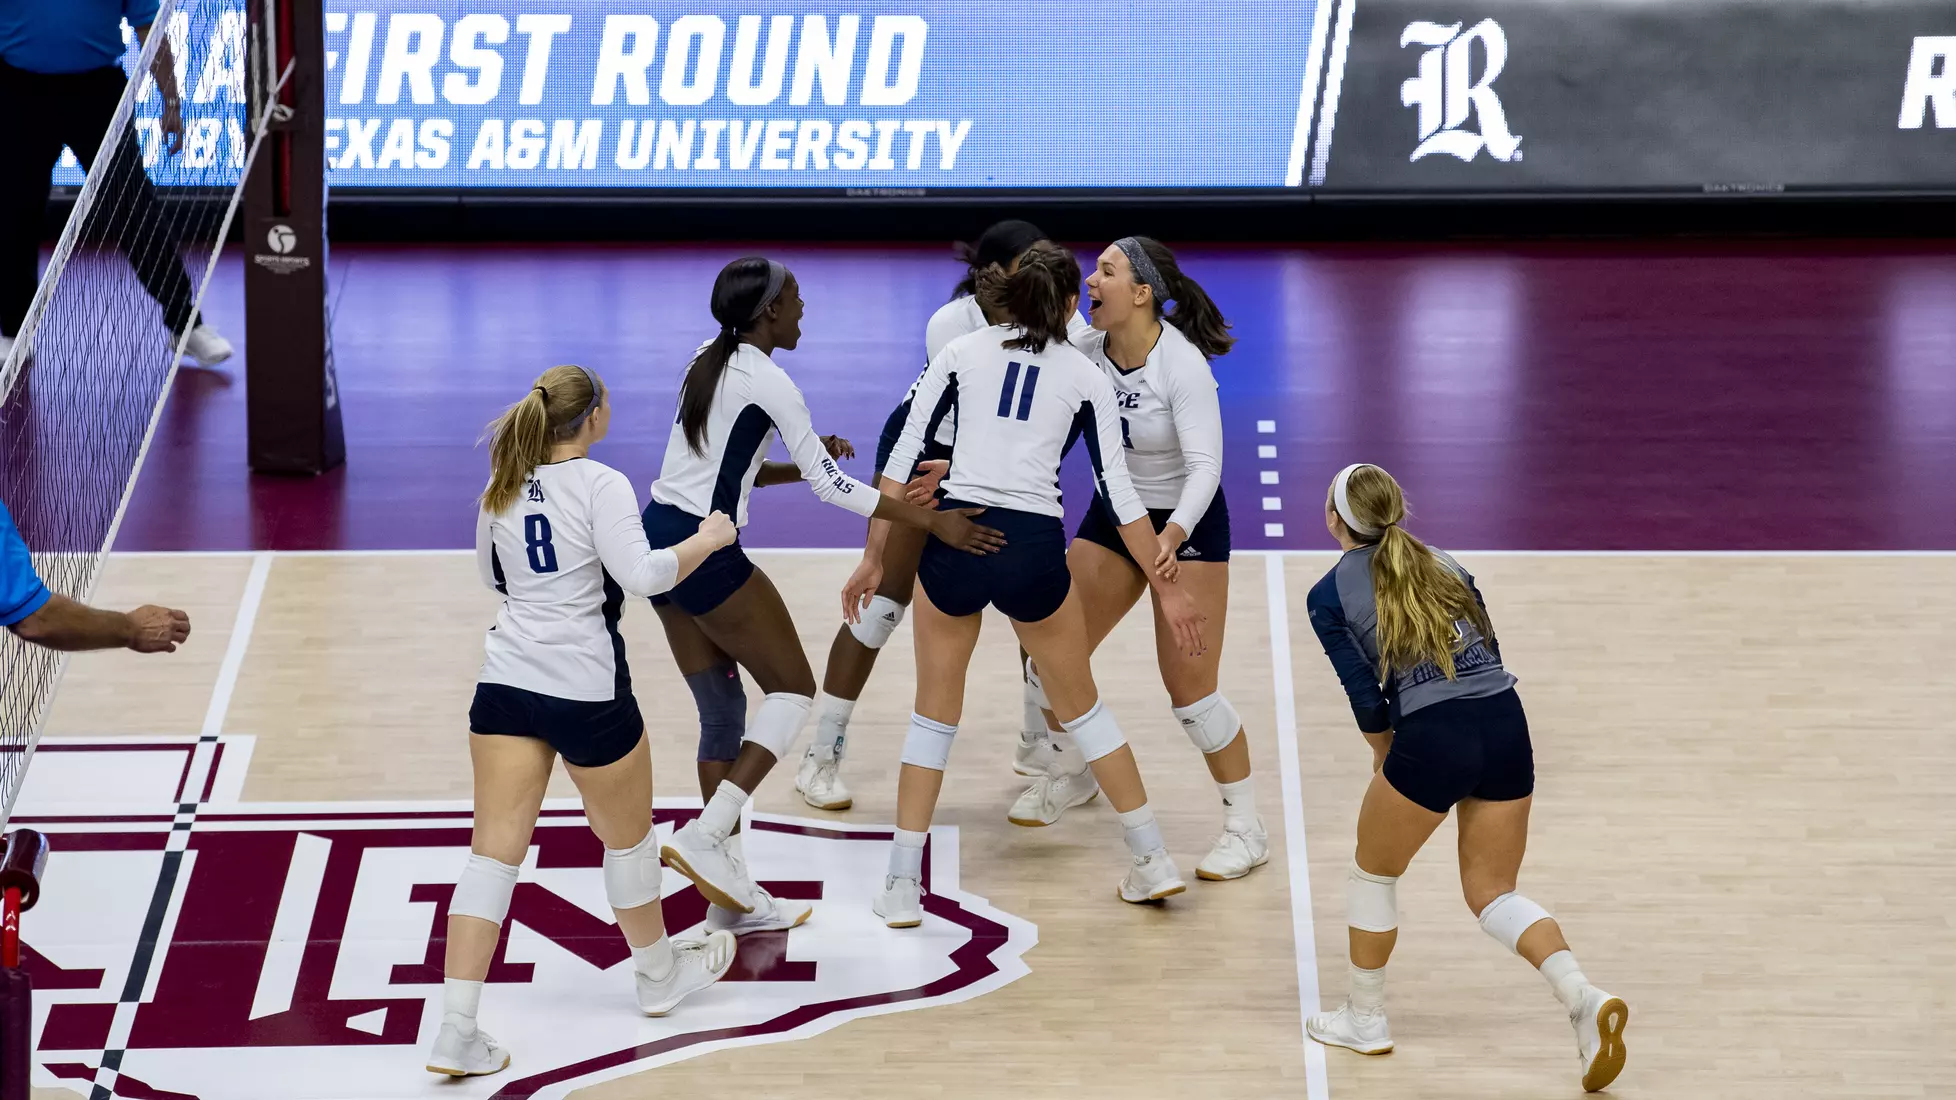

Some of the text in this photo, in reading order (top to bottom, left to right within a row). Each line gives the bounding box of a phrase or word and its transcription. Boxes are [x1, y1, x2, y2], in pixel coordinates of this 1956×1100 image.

[590, 14, 927, 106] ROUND
[1400, 17, 1523, 162] R
[325, 118, 453, 169] EXAS
[467, 119, 602, 169] A&M
[616, 119, 972, 170] UNIVERSITY
[996, 361, 1040, 421] 11
[524, 513, 559, 573] 8
